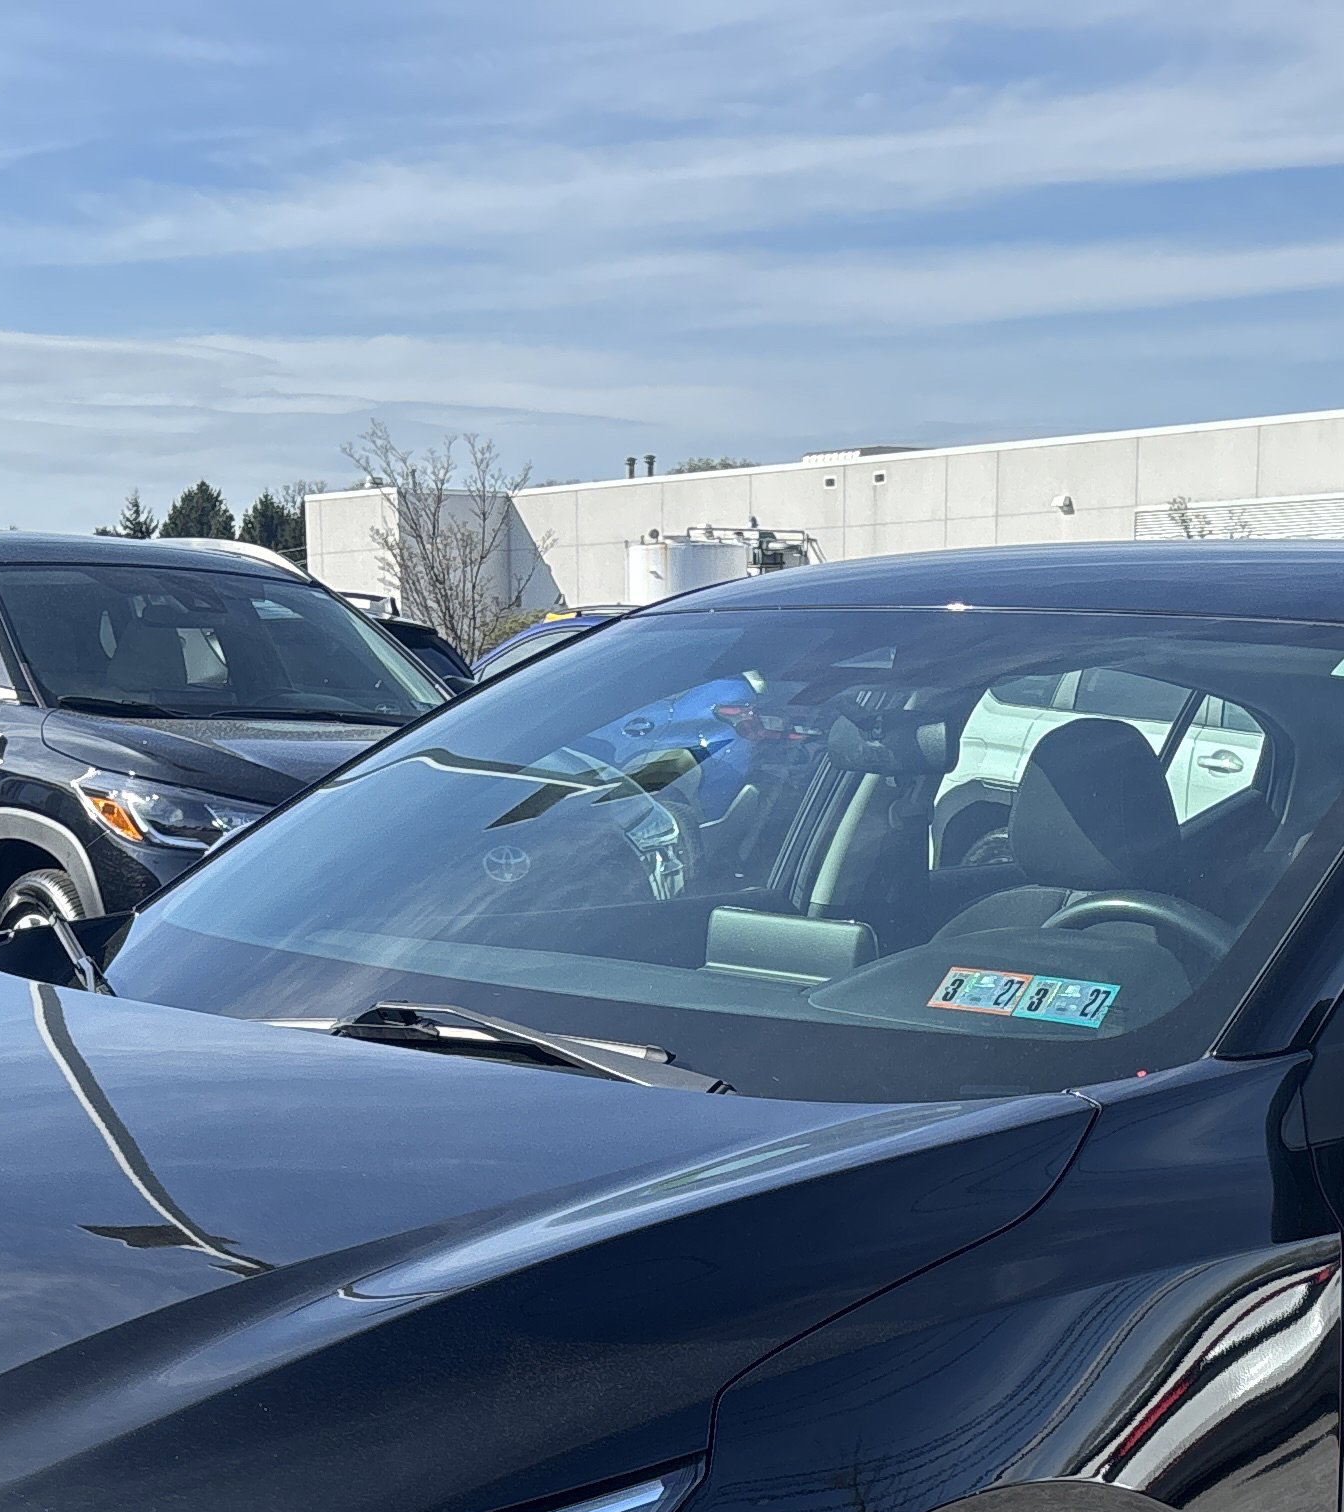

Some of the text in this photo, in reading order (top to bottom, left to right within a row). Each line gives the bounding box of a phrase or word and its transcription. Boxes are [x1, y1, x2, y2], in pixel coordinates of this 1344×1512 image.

[942, 978, 1025, 1009] 3 27
[1027, 987, 1111, 1020] 3 27
